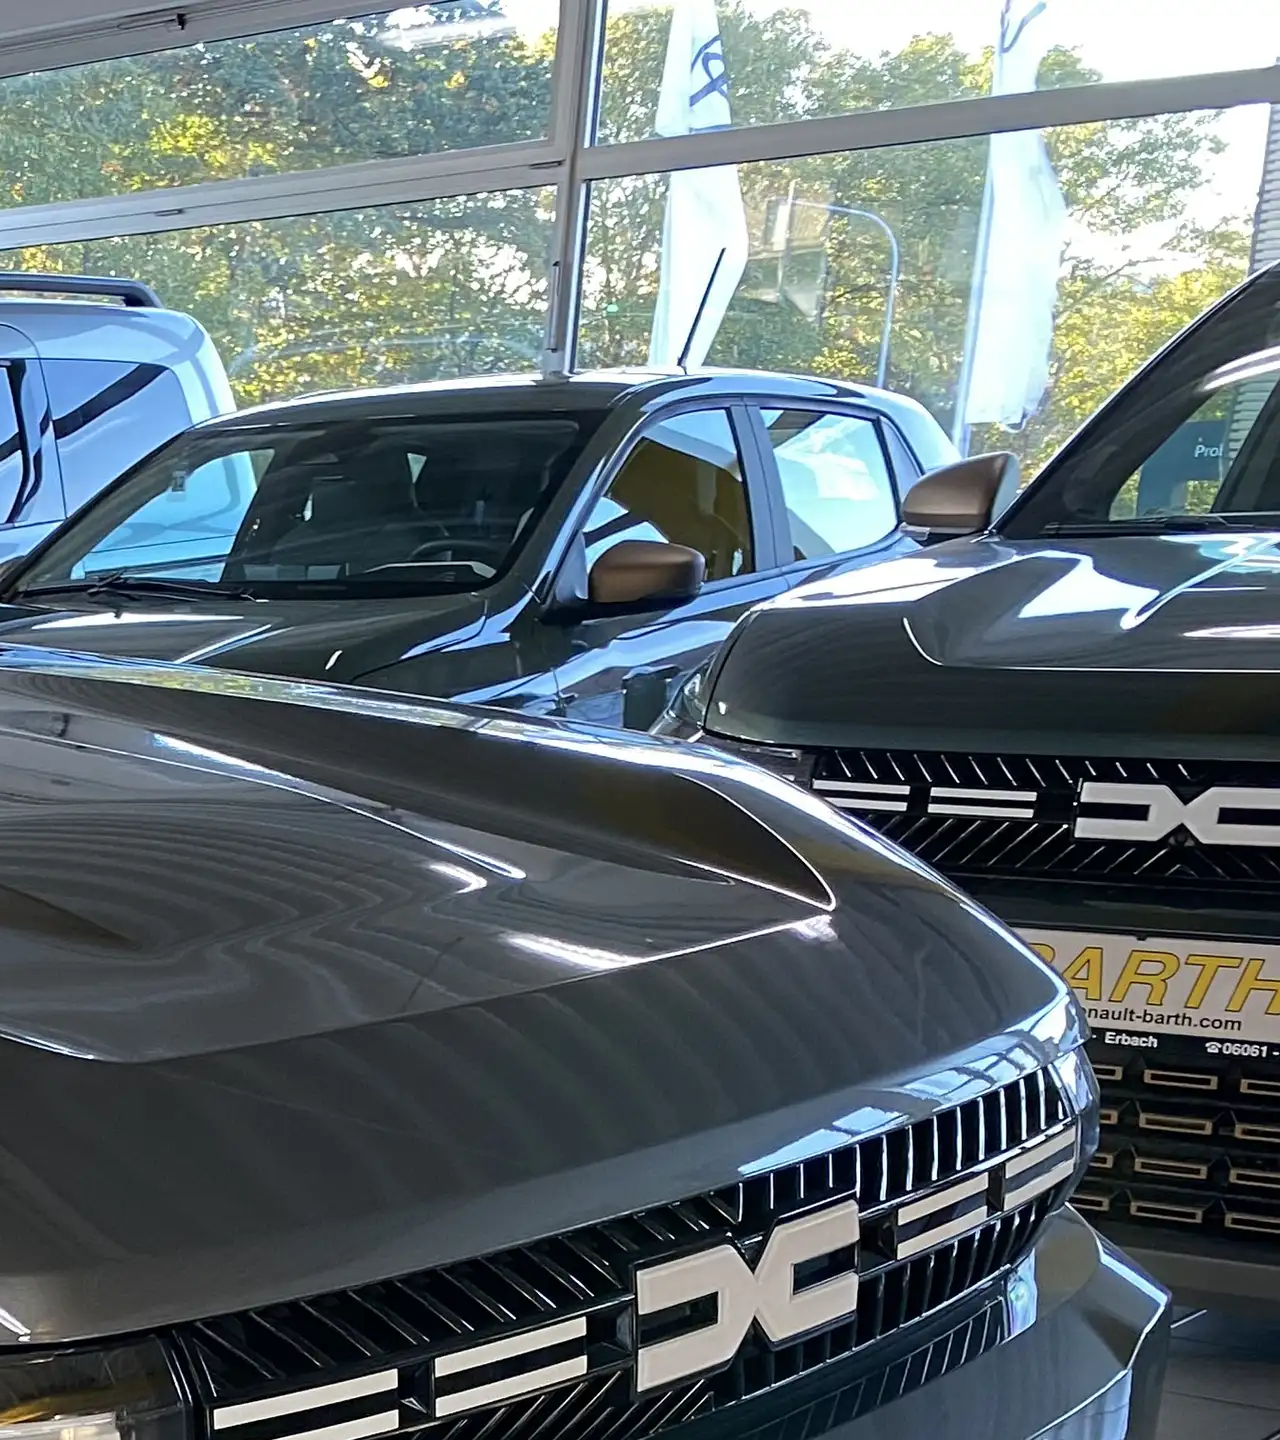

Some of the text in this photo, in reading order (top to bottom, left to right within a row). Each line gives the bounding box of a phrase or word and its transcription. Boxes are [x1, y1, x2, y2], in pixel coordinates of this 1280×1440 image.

[1082, 1006, 1242, 1032] nault-barth.com
[1104, 1031, 1159, 1048] Erbach
[1222, 1042, 1268, 1058] 06061
